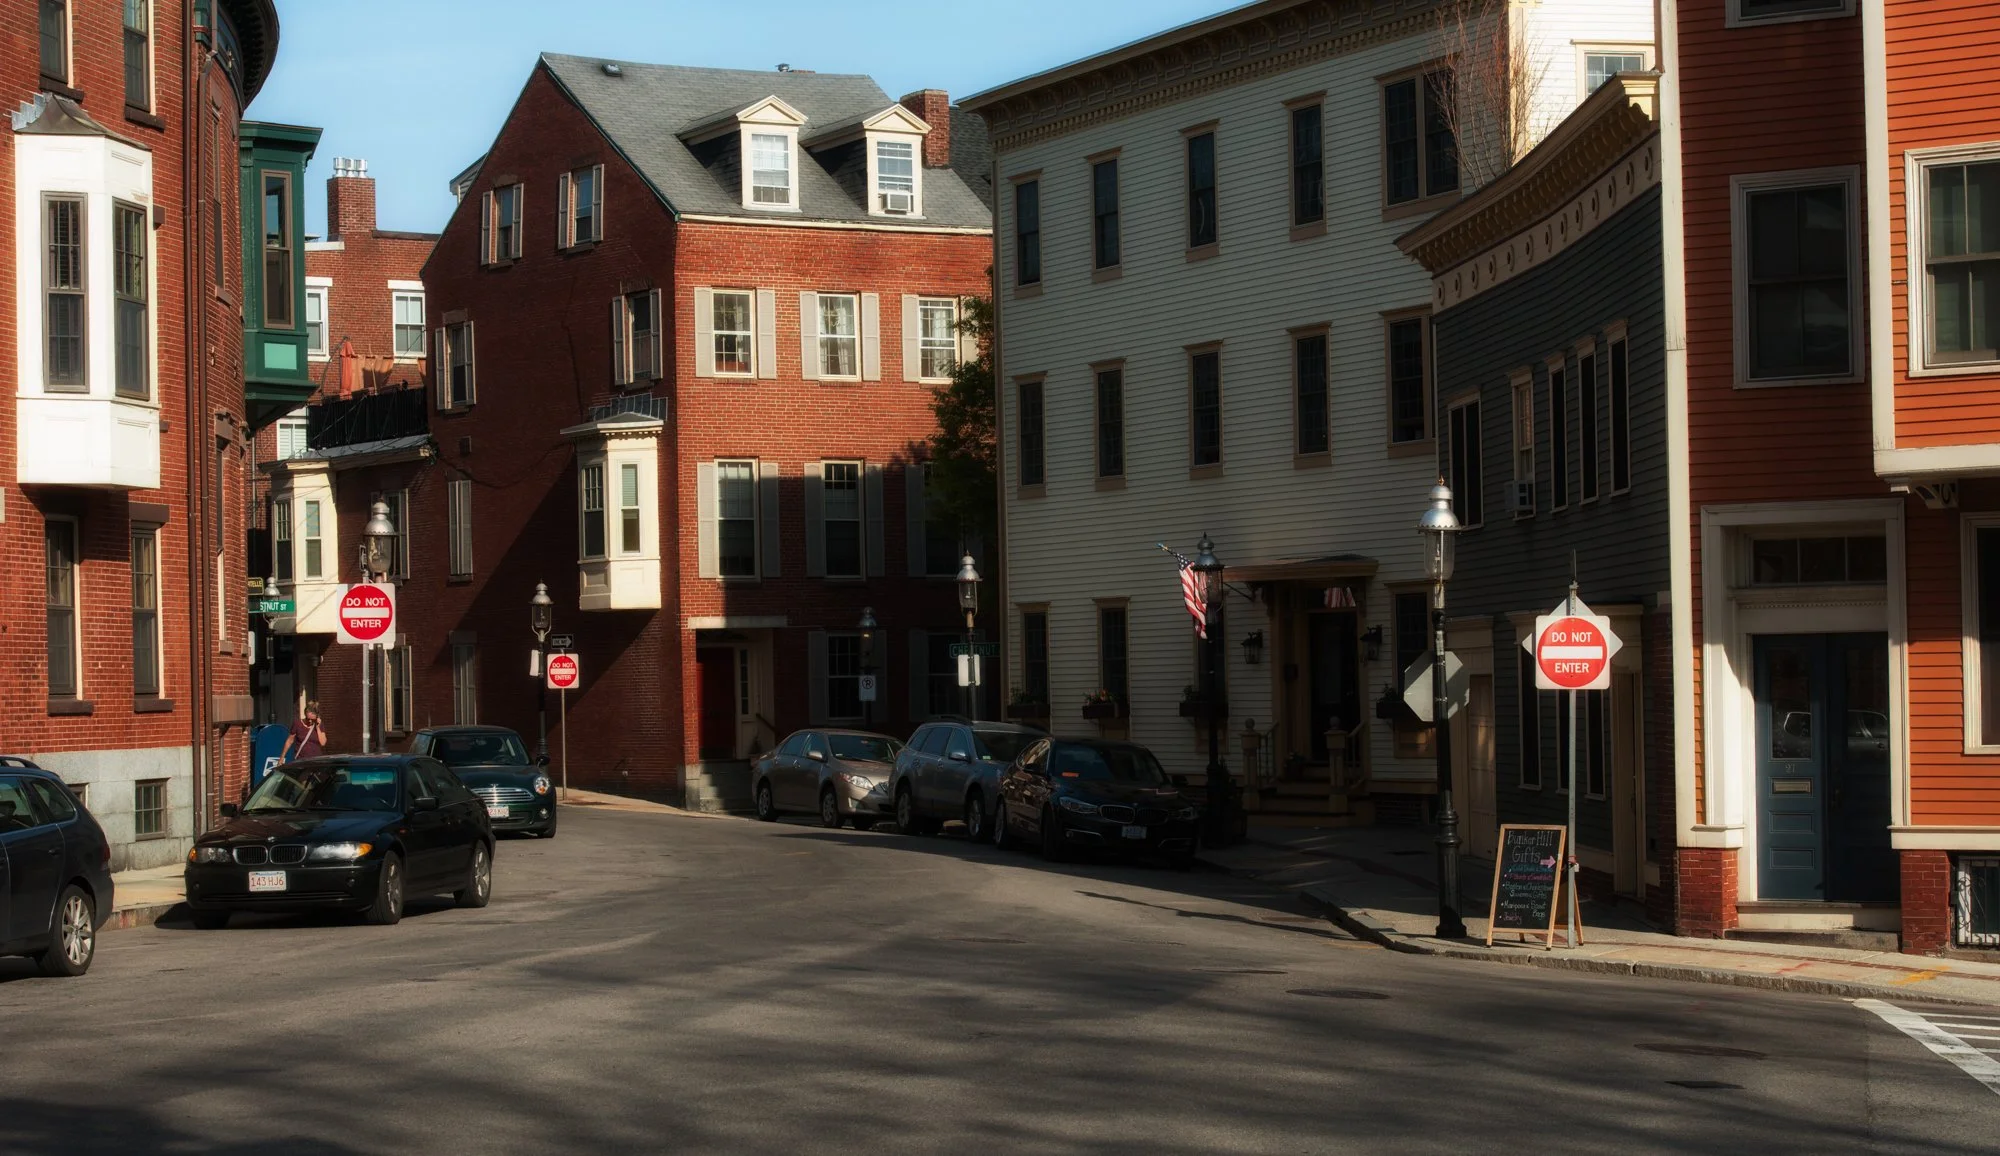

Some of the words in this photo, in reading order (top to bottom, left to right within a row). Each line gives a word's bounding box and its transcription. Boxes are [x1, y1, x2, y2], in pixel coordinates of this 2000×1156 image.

[346, 597, 361, 607] DO
[365, 597, 385, 607] NOT
[350, 619, 382, 628] ENTER
[1551, 632, 1567, 643] DO
[1571, 632, 1592, 643] NOT
[1555, 663, 1589, 673] ENTER
[1507, 831, 1536, 846] Bunker
[1536, 831, 1554, 847] Hill
[1512, 845, 1541, 864] Gifts
[251, 877, 266, 887] 143
[267, 876, 284, 886] HJ6
